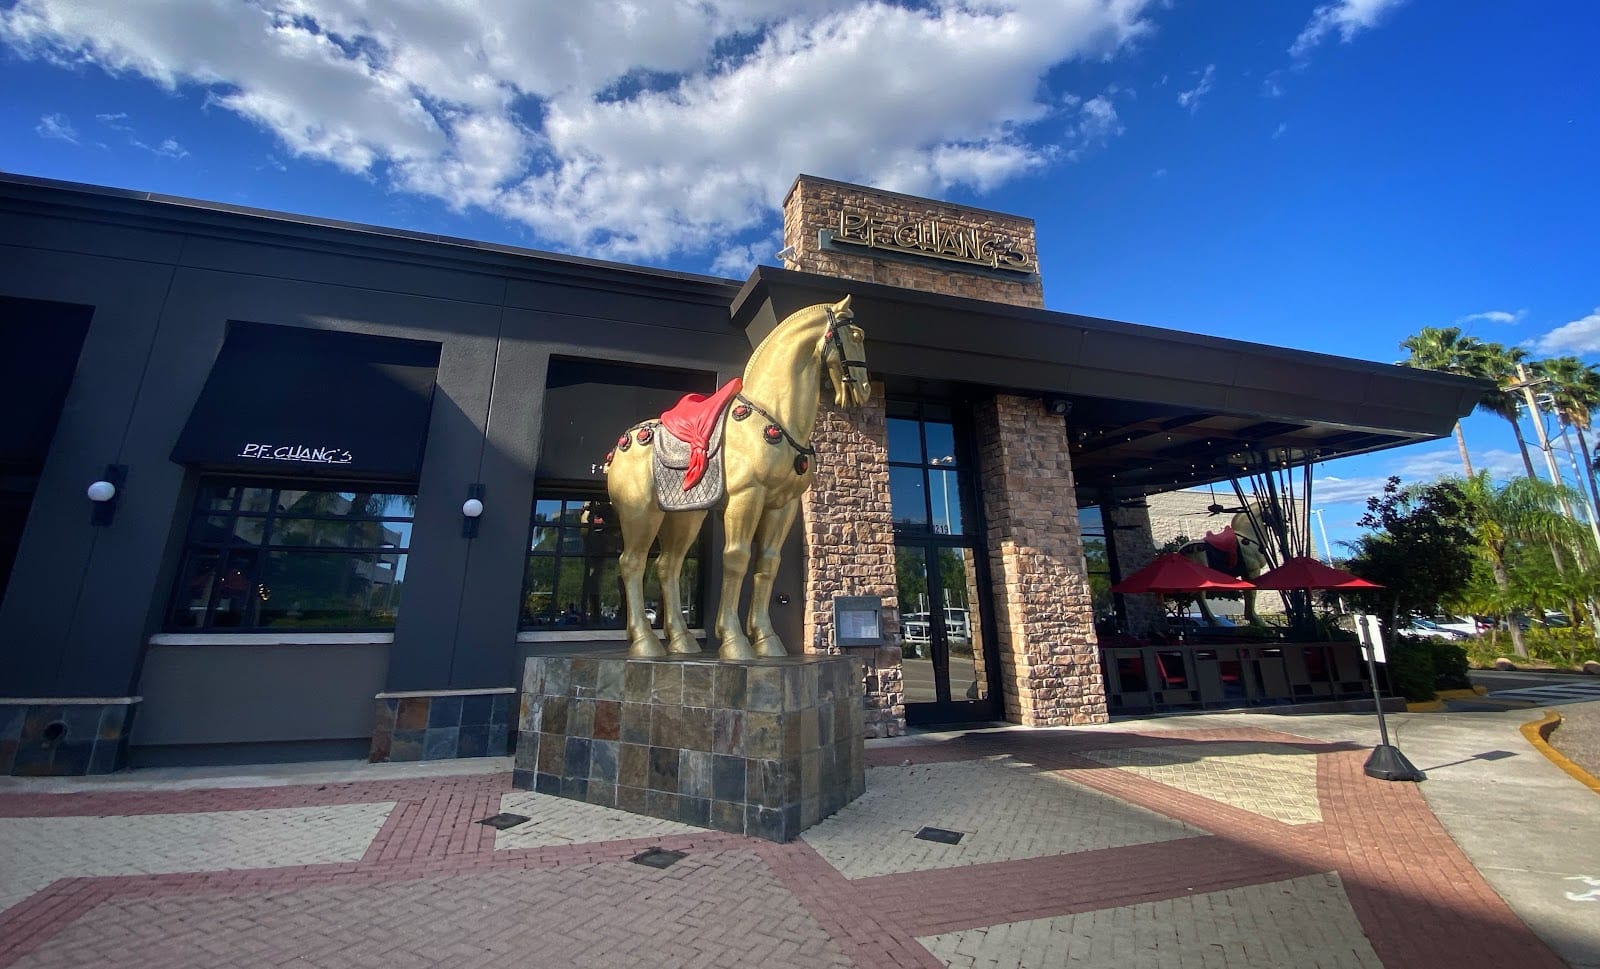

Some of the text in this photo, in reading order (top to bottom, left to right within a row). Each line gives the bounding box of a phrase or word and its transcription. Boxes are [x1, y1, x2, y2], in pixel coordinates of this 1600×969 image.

[894, 221, 1029, 269] CHANG'S
[243, 443, 353, 464] P.F. CHANG'S
